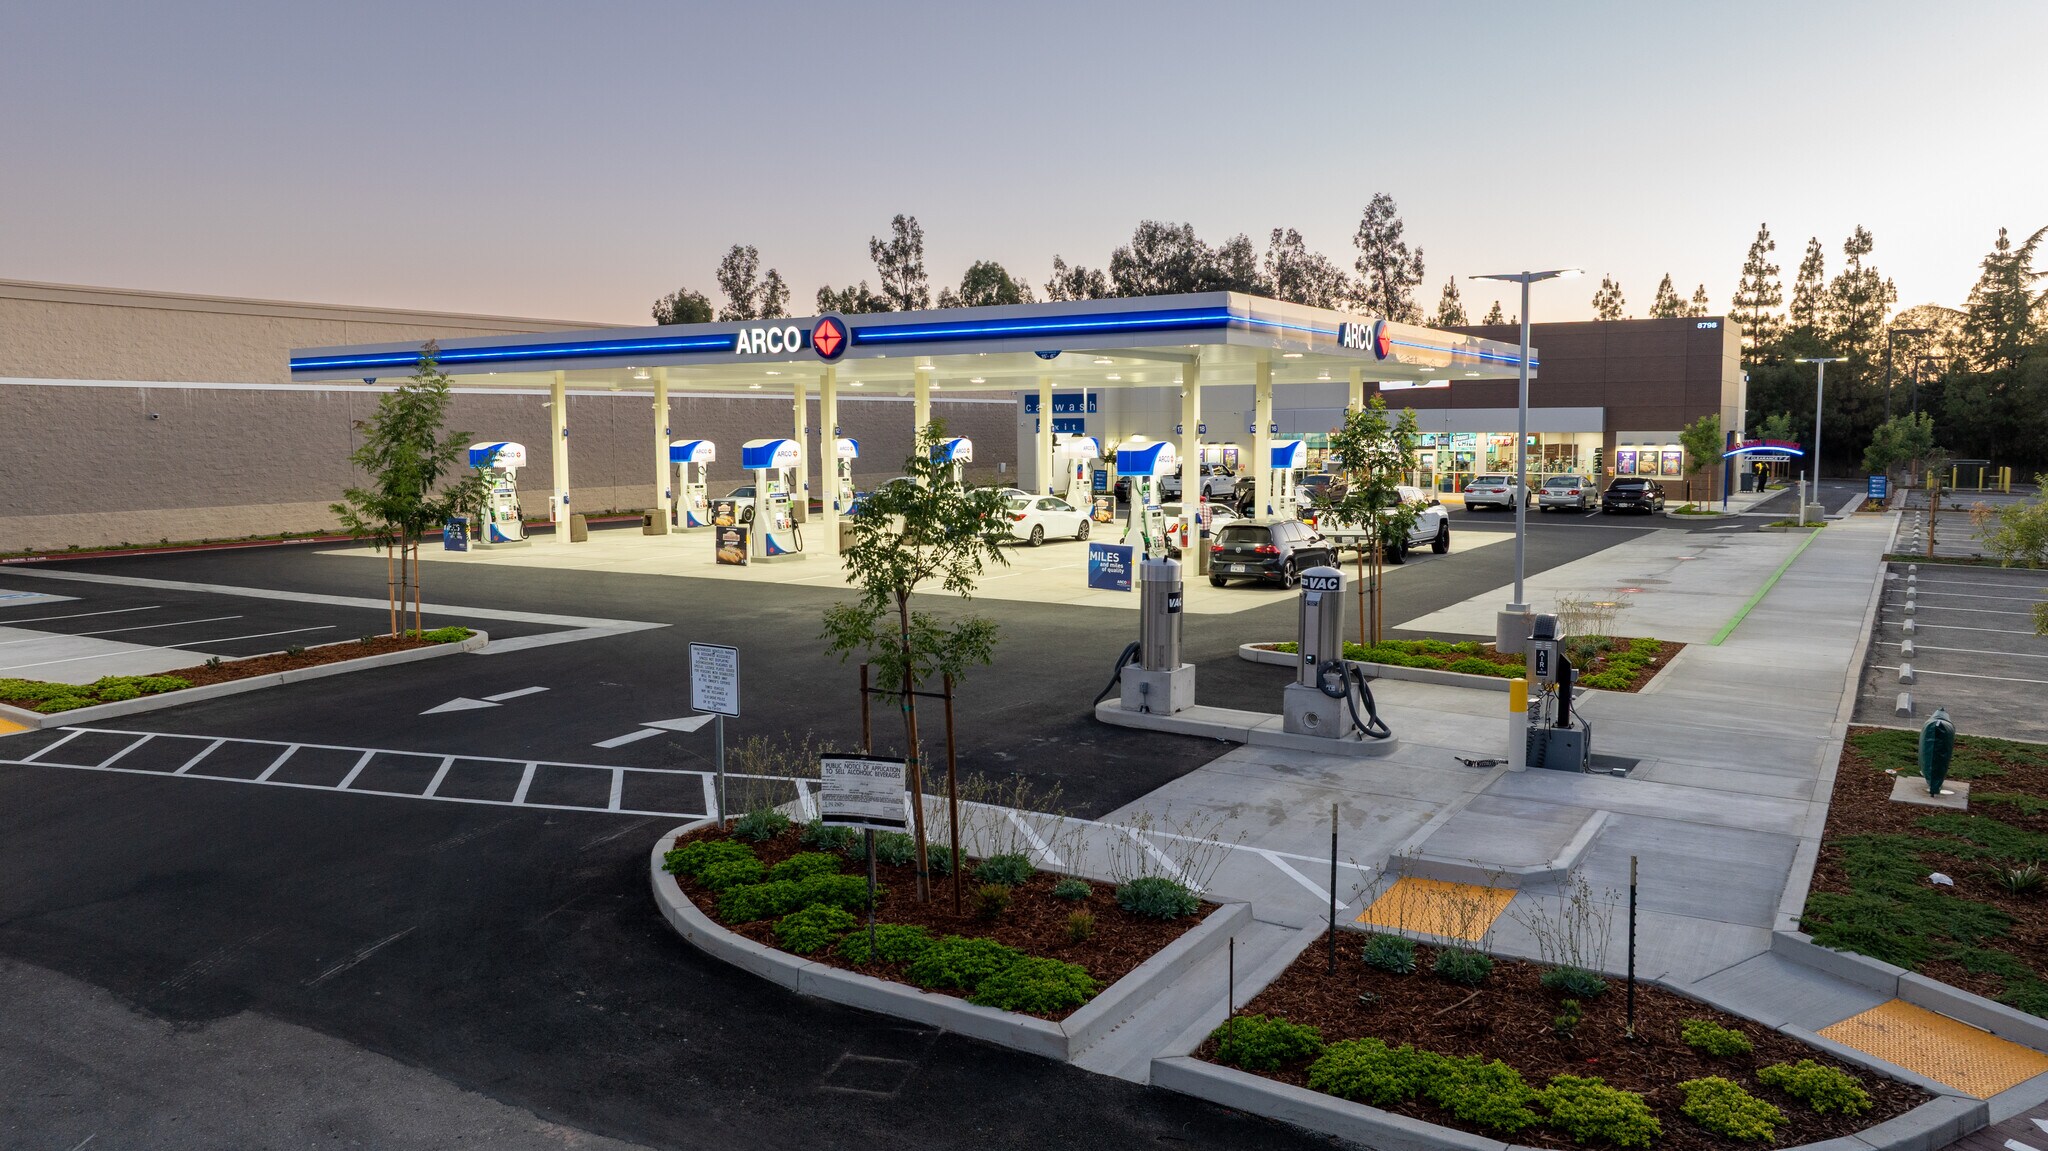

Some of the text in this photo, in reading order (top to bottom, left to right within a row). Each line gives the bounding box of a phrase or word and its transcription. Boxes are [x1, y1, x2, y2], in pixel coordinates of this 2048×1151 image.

[736, 326, 801, 354] ARCO
[1344, 322, 1373, 351] ARCO
[1055, 401, 1096, 411] wash
[1089, 551, 1120, 562] MILES
[1309, 577, 1338, 590] VAC
[847, 769, 873, 777] ALCOHOLIC
[874, 771, 901, 779] BEVERAGES
[871, 765, 901, 773] APPLICATION
